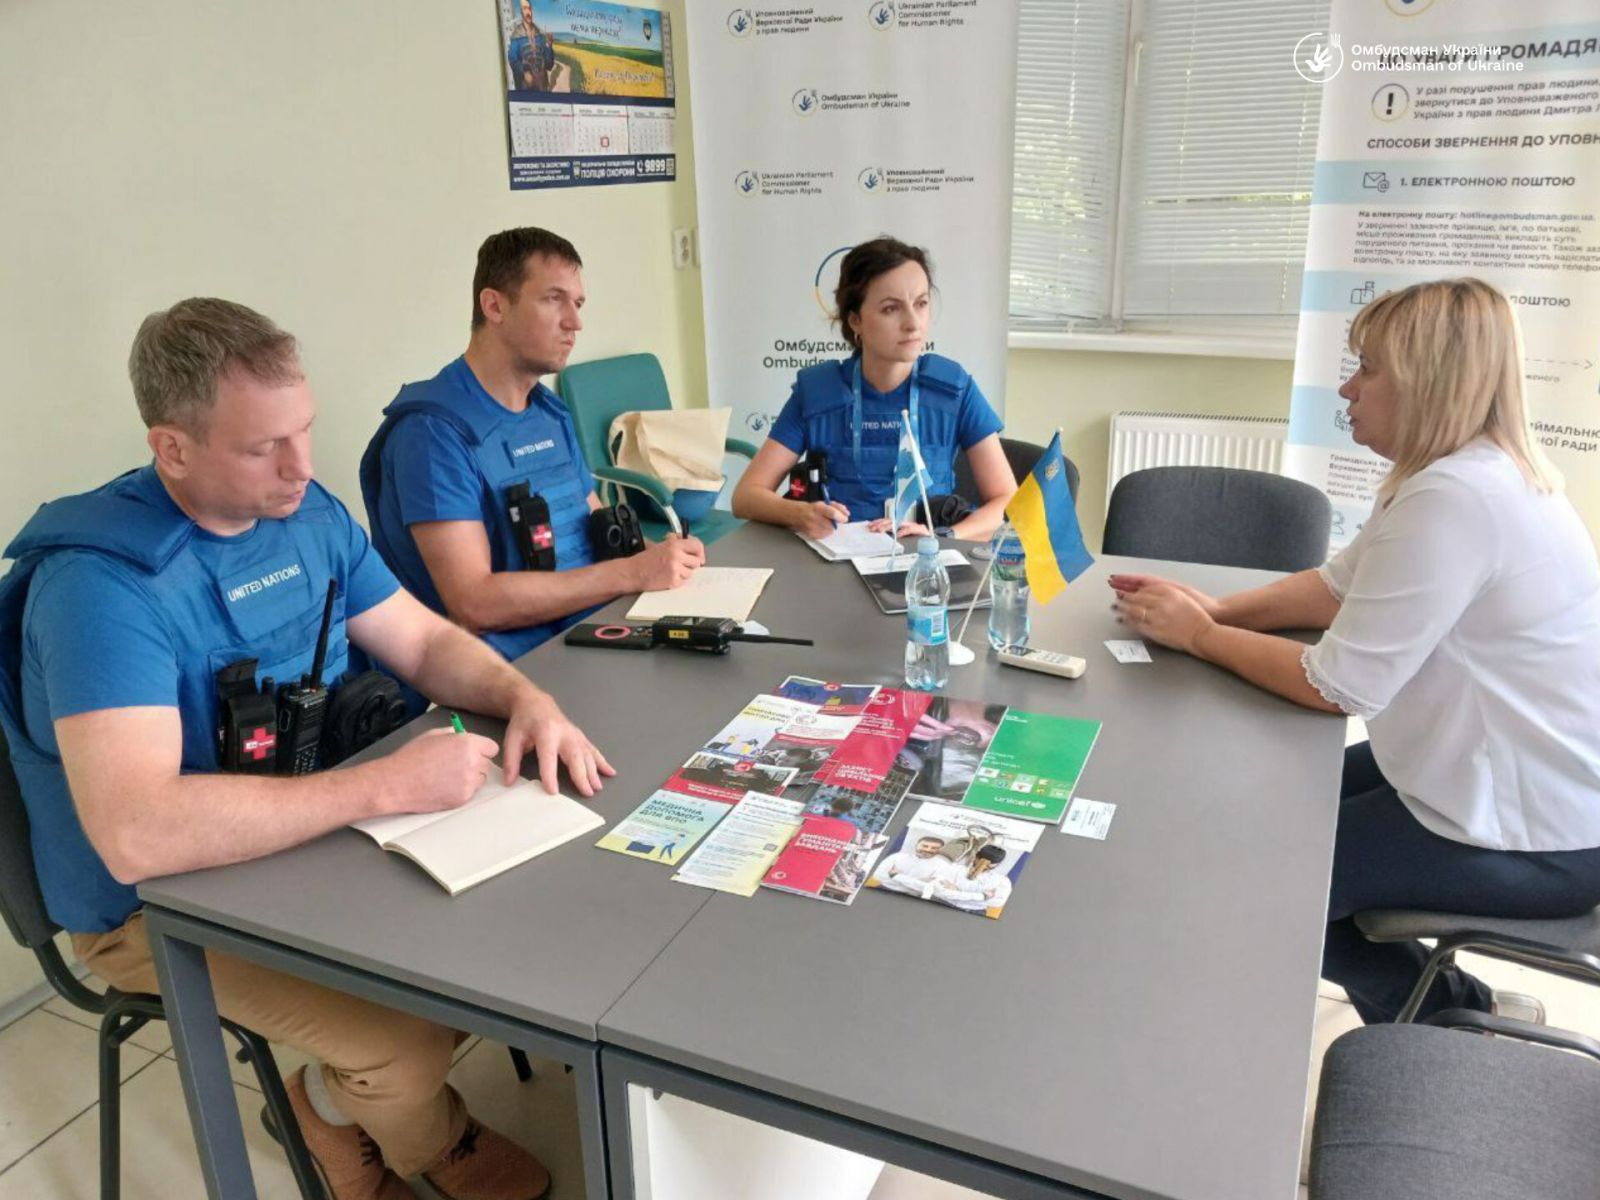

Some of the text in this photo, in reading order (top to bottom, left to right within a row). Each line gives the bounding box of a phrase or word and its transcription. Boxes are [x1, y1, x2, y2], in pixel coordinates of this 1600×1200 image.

[898, 0, 977, 10] Ukrainian Parliament
[940, 18, 964, 26] Rights
[1485, 38, 1600, 61] ГРОМАДЯ
[1450, 85, 1514, 96] порушення
[1517, 82, 1545, 92] прав
[821, 102, 869, 111] Ombudsman
[880, 101, 910, 109] Ukraine
[1414, 91, 1599, 108] звернутися до Уповноваженого
[1413, 110, 1454, 120] України
[1465, 110, 1492, 119] прав
[1495, 107, 1541, 117] людини
[1543, 105, 1592, 116] Дмитра
[1367, 138, 1431, 149] СПОСОБИ
[1434, 135, 1519, 148] ЗВЕРНЕННЯ
[1521, 134, 1544, 148] ДО
[644, 159, 666, 172] 9899
[1411, 176, 1508, 187] ЕЛЕКТРОННОЮ
[1511, 176, 1576, 187] ПОШТОЮ
[1372, 211, 1423, 220] електронну
[1425, 212, 1457, 220] пошту:
[1509, 294, 1571, 308] ПОШТОЮ
[774, 339, 853, 354] Омбудсма
[881, 421, 902, 430] NATI
[1530, 421, 1600, 439] ЙМАЛЬНЮ
[512, 439, 555, 458] UNITED NATIONS
[1561, 439, 1598, 453] РАДИ
[227, 564, 301, 602] UNITED NATIONS
[994, 796, 1032, 808] unicef
[645, 804, 704, 822] ДОПОМОГА
